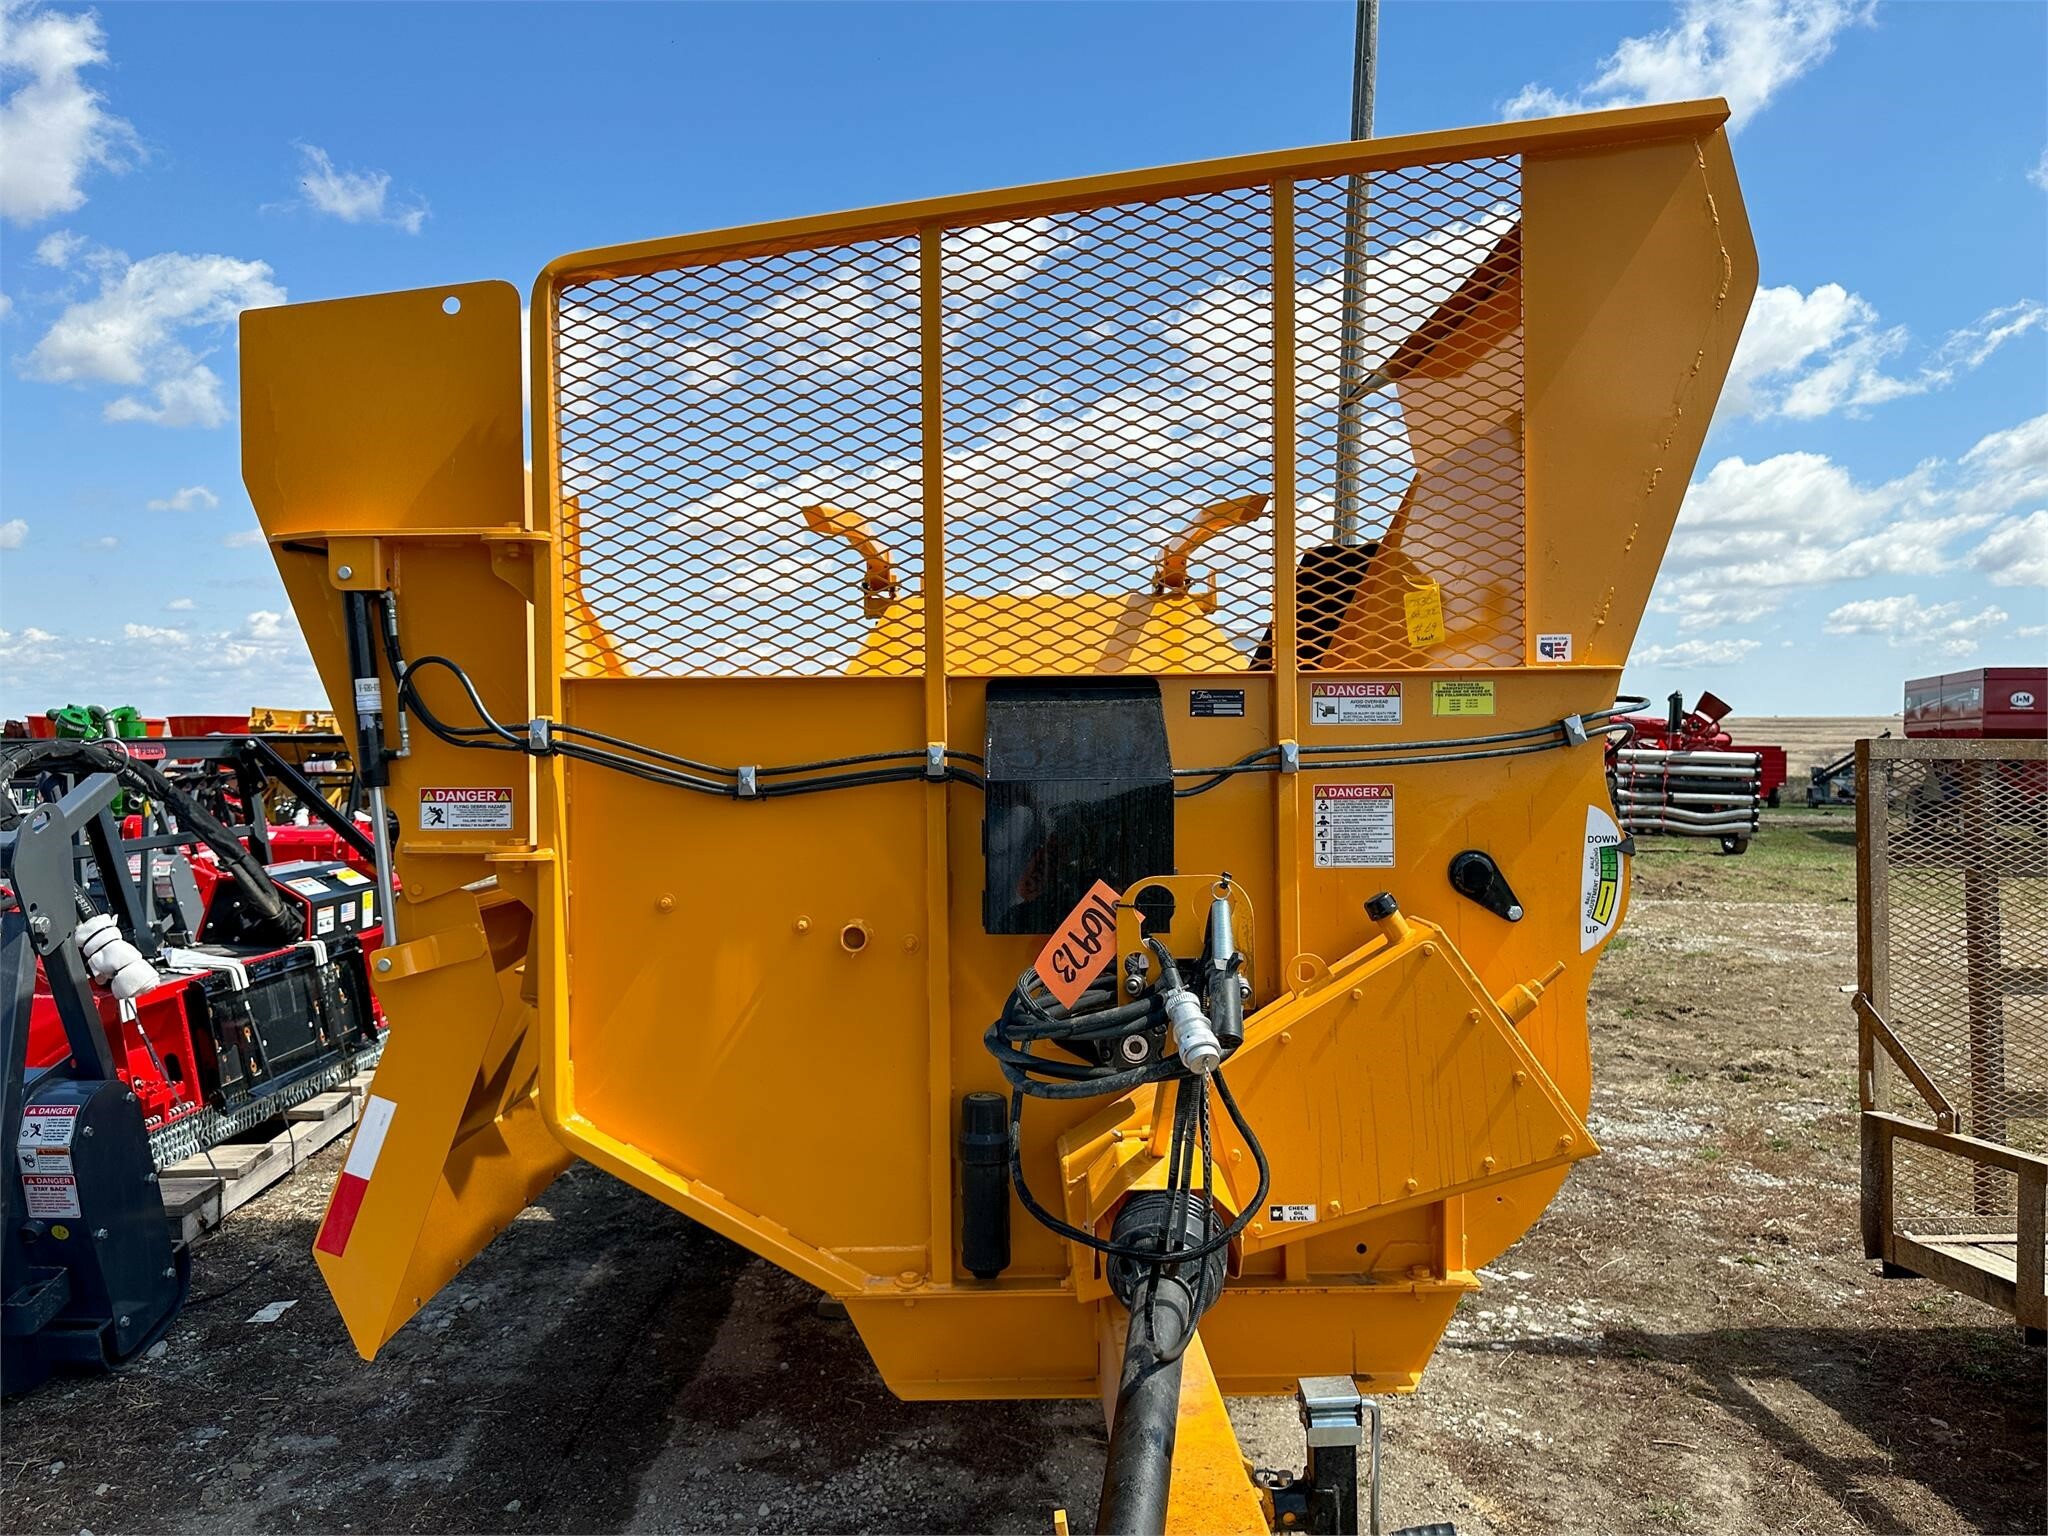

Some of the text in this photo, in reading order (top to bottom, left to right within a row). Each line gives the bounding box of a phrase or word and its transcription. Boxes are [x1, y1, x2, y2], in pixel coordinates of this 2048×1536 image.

[1326, 685, 1385, 696] DANGER
[436, 791, 497, 801] DANGER
[1329, 788, 1379, 796] DANGER
[1588, 835, 1618, 844] DOWN
[1587, 880, 1599, 918] ADJUSTMENT
[1052, 894, 1117, 984] 16973
